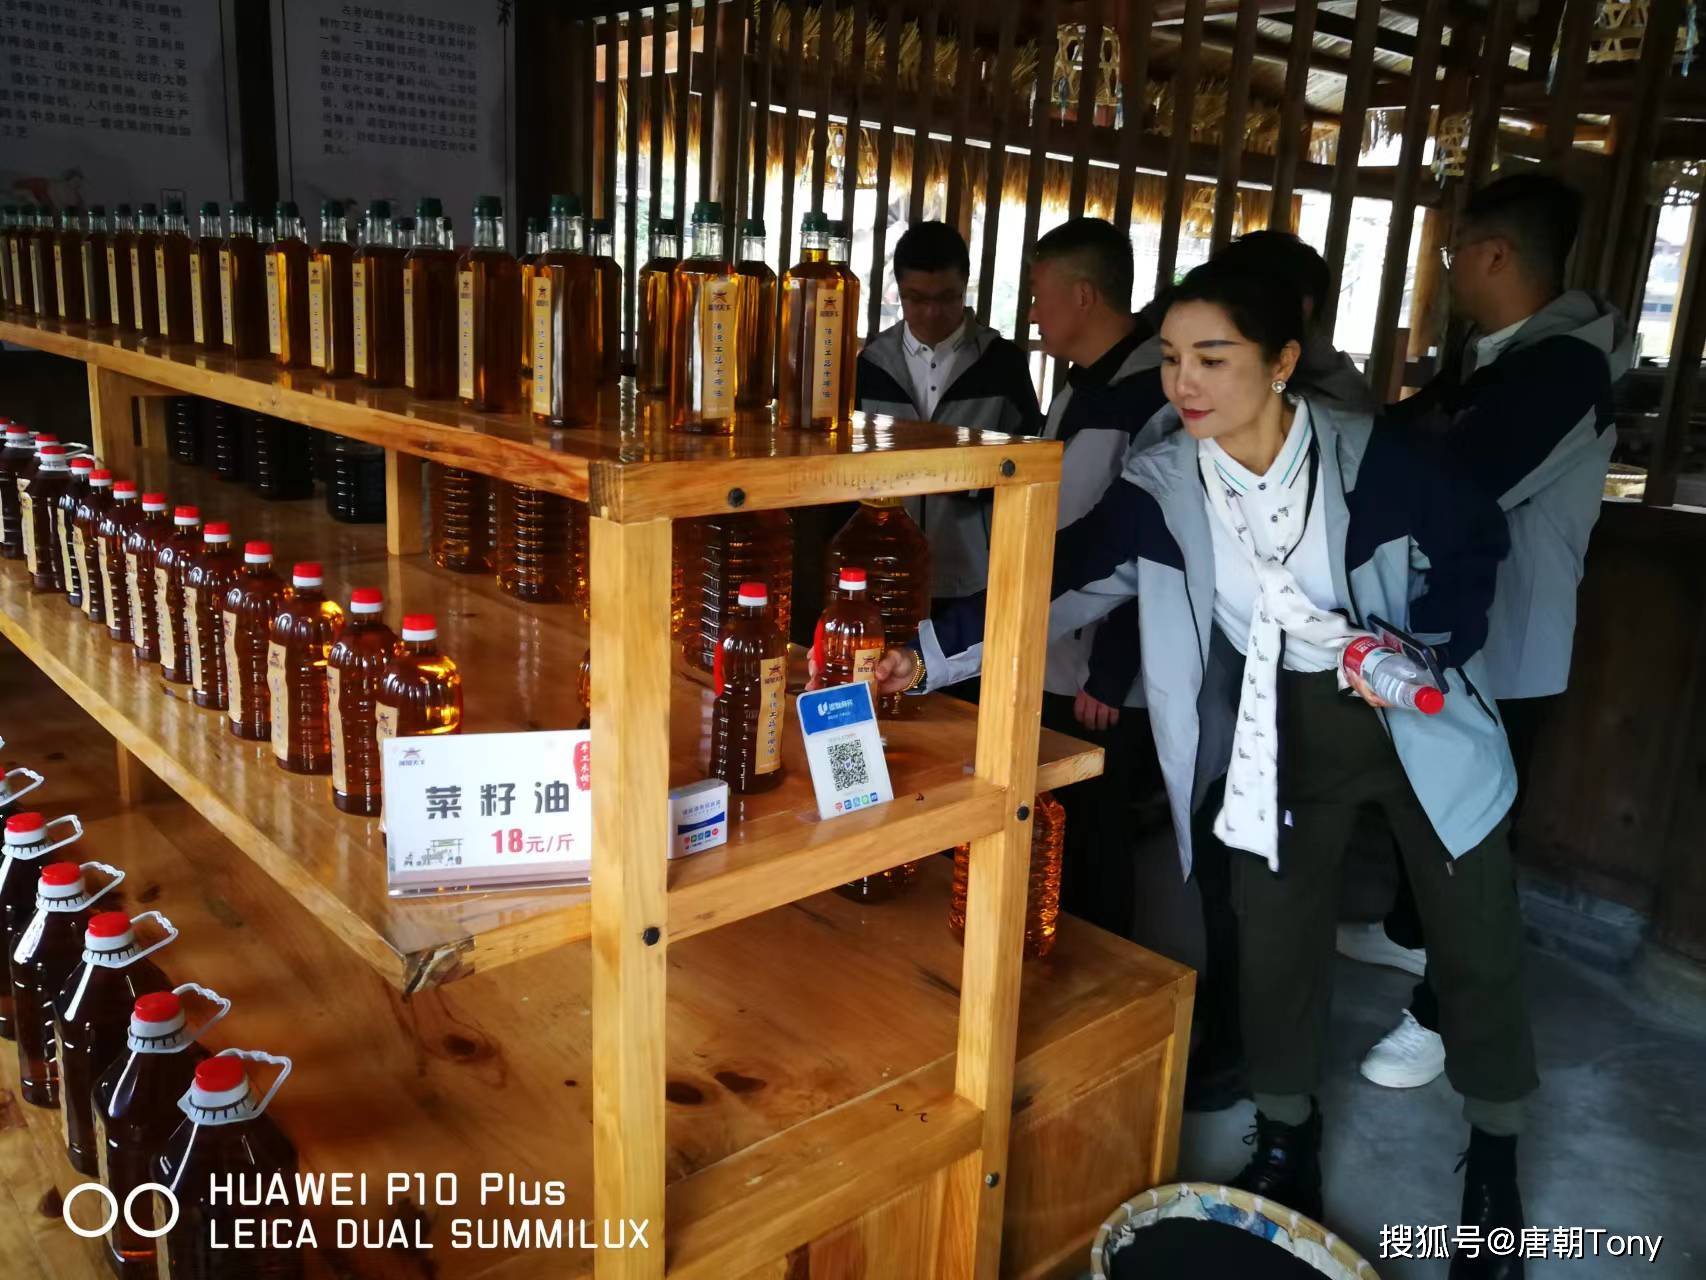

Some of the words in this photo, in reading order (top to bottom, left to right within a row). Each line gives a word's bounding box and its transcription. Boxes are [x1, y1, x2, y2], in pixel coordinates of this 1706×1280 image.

[425, 780, 570, 819] 菜籽油
[491, 828, 575, 854] 18元/斤
